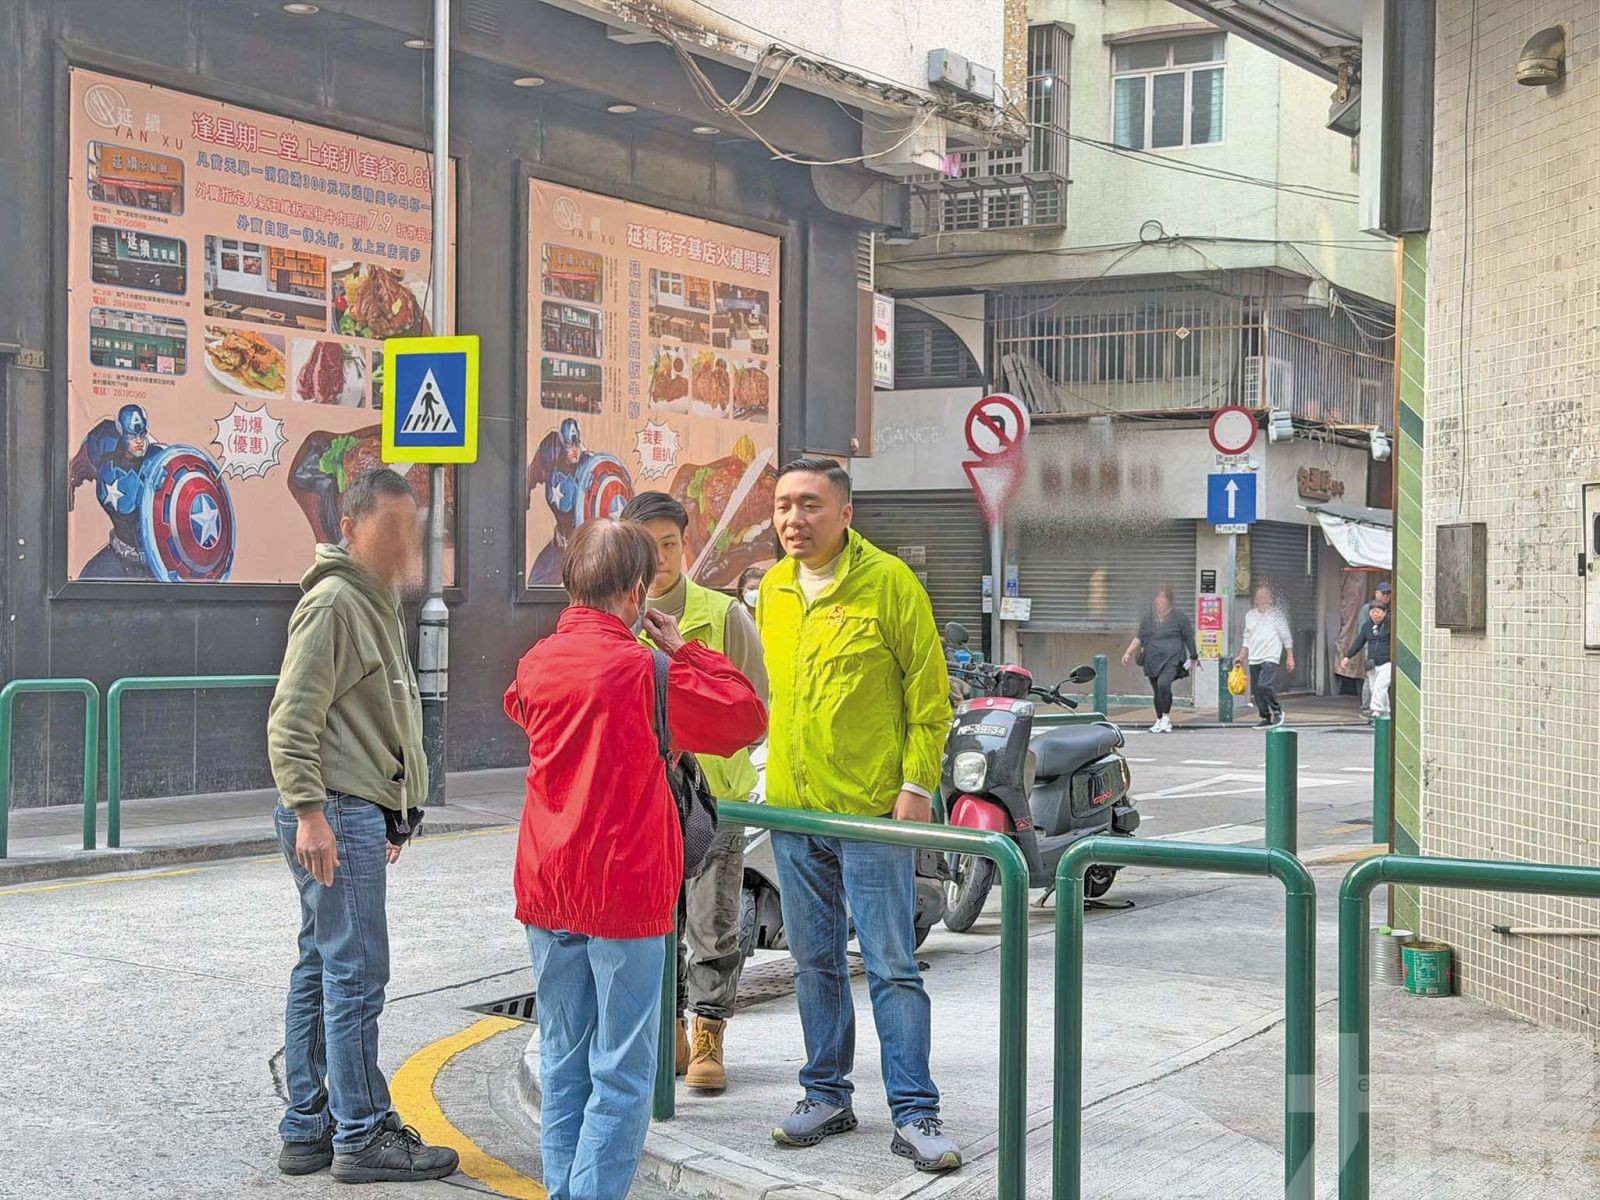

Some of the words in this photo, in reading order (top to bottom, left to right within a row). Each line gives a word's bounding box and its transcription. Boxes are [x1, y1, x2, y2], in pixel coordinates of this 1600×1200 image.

[114, 126, 149, 143] YAN
[162, 135, 184, 150] XU
[233, 415, 263, 434] 勁爆
